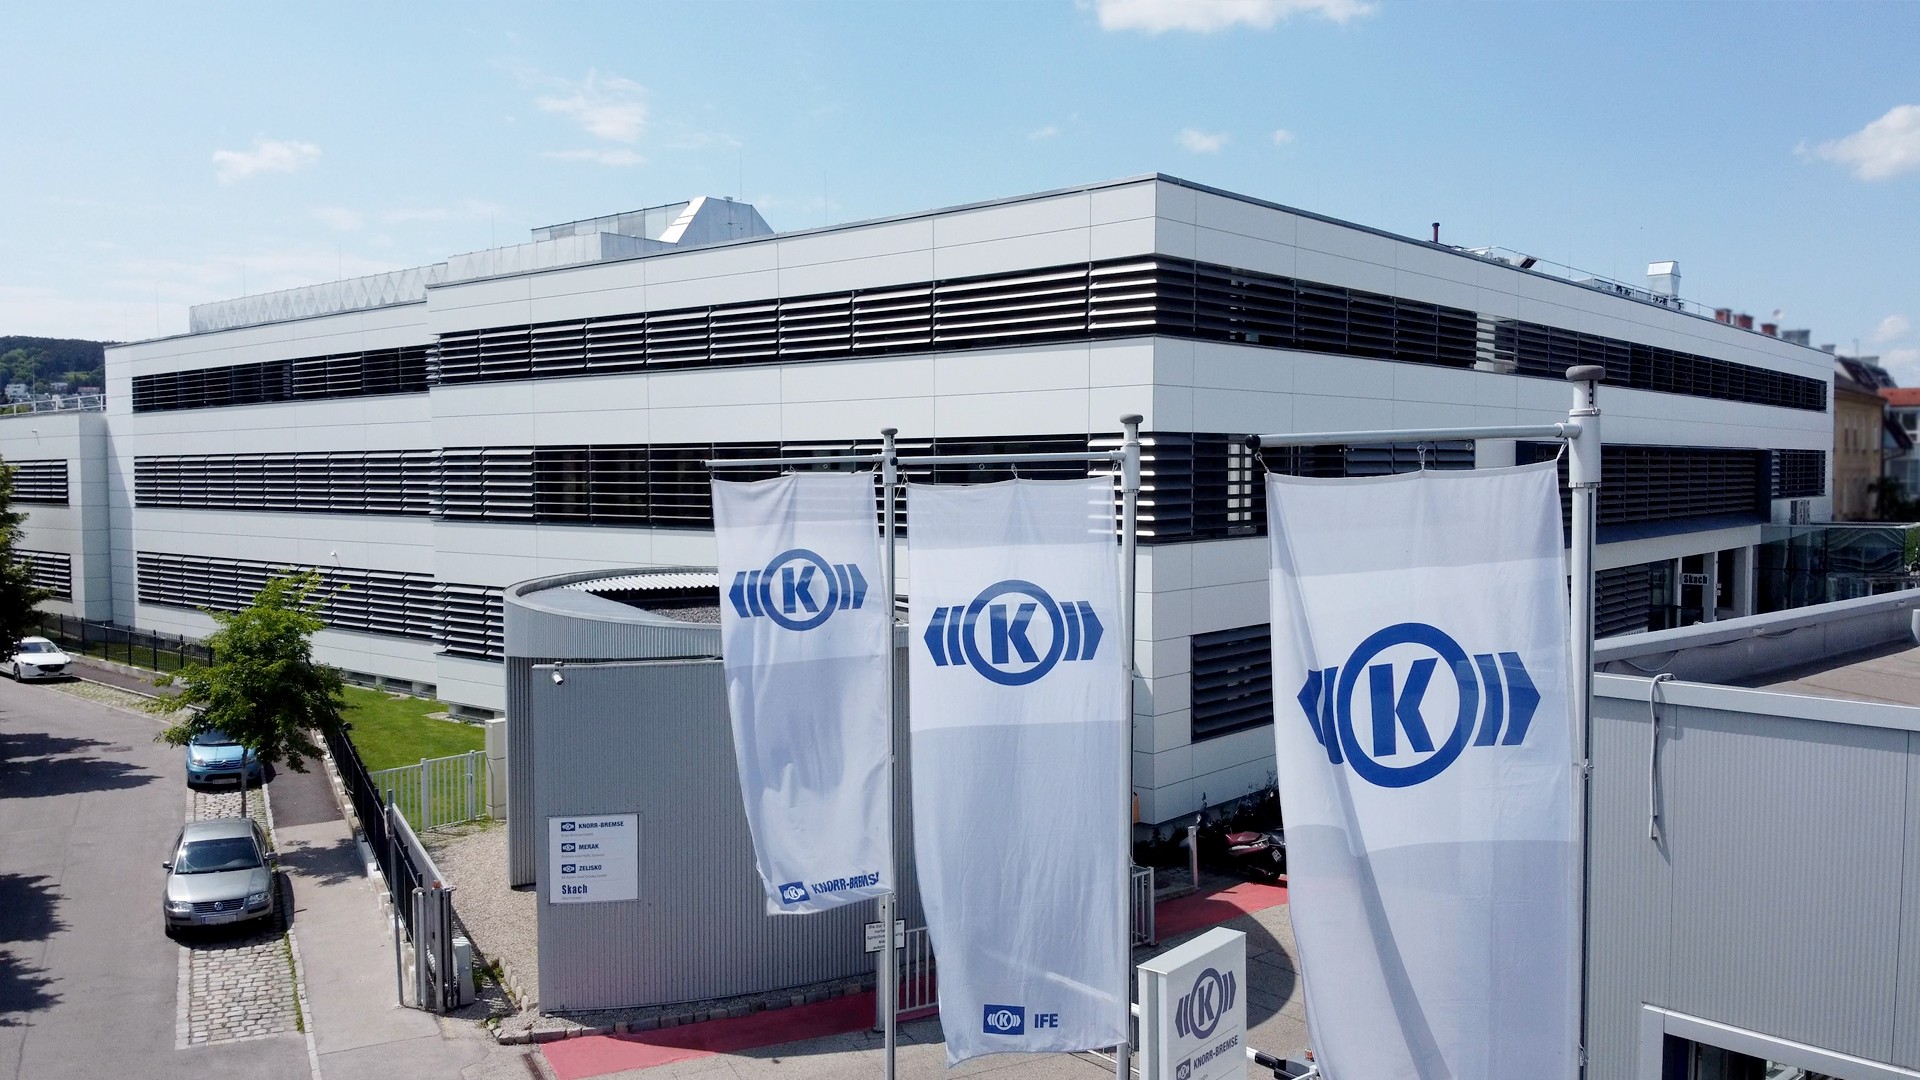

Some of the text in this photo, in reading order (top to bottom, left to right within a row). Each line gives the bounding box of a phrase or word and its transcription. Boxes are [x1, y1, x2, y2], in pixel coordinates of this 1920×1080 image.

[782, 566, 819, 614] K
[1684, 575, 1707, 584] Skach
[989, 602, 1040, 665] K
[1369, 657, 1439, 758] K
[579, 821, 624, 829] KNORR-BREMSE
[578, 864, 602, 872] ZELISKO
[561, 883, 588, 895] Skach
[1197, 980, 1215, 1027] K
[1034, 1013, 1059, 1029] IFE
[1193, 1034, 1239, 1070] KNORR-BREMSE
